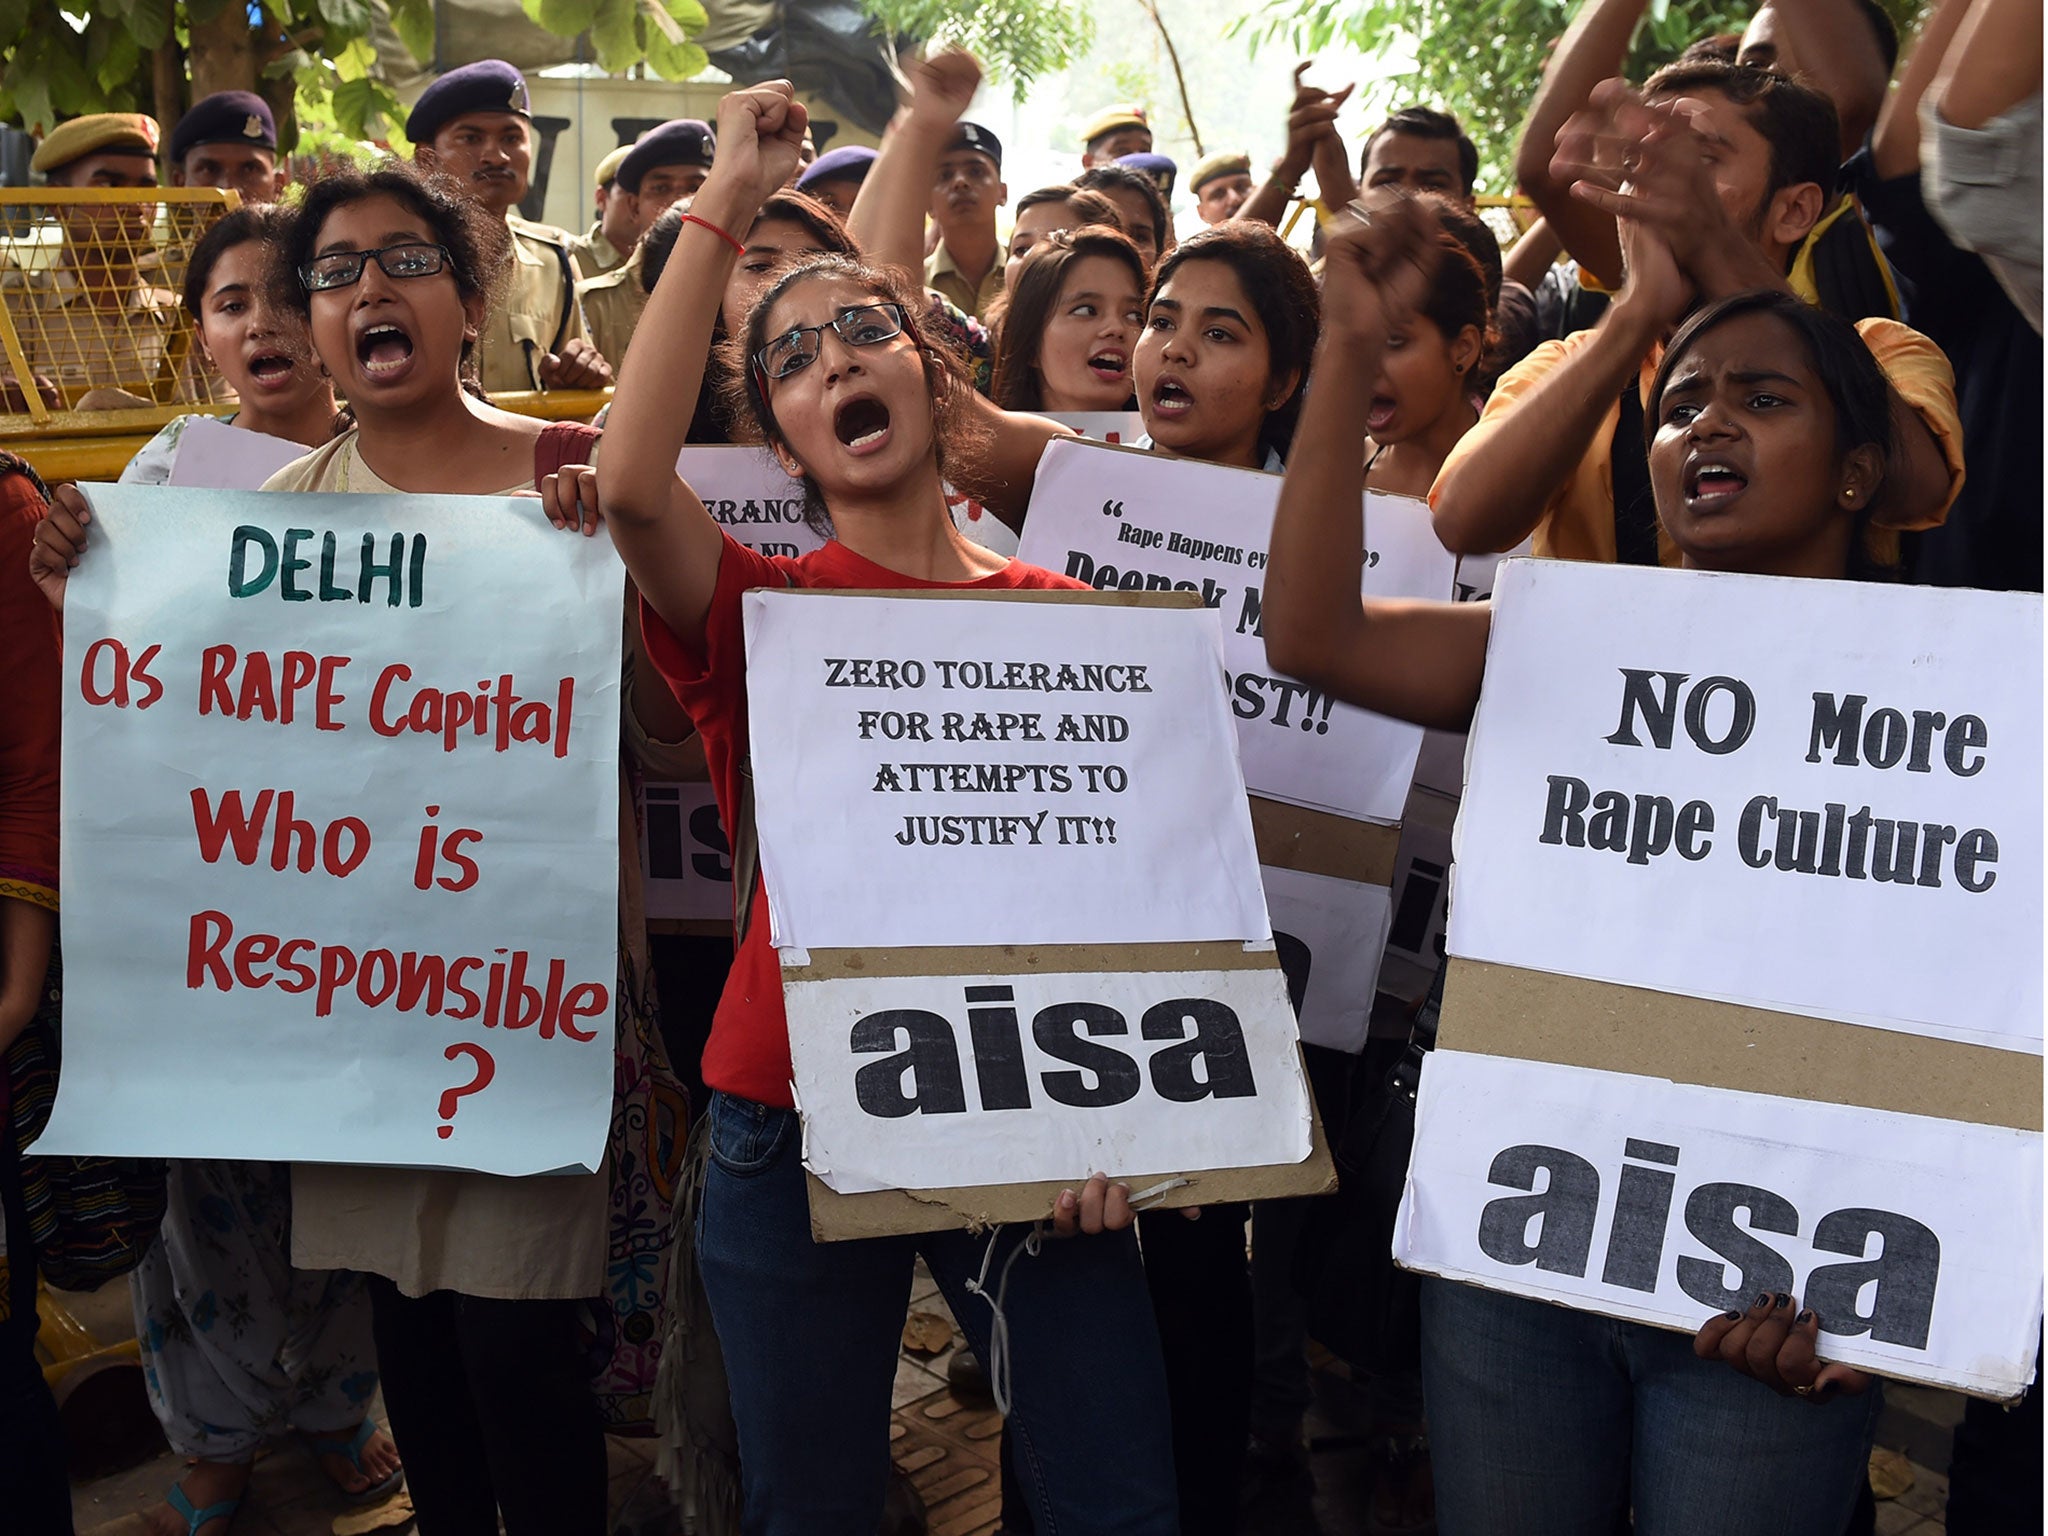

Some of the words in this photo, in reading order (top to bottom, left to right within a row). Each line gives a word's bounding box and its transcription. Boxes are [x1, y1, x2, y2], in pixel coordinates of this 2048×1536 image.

[228, 525, 427, 609] DELHI
[1117, 522, 1164, 549] Rape
[1167, 531, 1244, 565] Happens
[1247, 550, 1270, 570] ev
[200, 644, 350, 731] RAPE
[369, 664, 574, 758] Capital
[824, 658, 925, 691] ZERO
[933, 660, 1153, 693] TOLERANCE
[1602, 668, 1756, 755] NO
[1805, 692, 1988, 777] More
[857, 711, 934, 743] FOR
[941, 712, 1046, 743] RAPE
[1054, 714, 1129, 743] AND
[872, 763, 1073, 793] ATTEMPTS
[1077, 765, 1128, 793] TO
[894, 810, 1049, 846] JUSTIFY
[1055, 816, 1117, 845] IT!!
[191, 788, 371, 878] Who
[415, 805, 483, 892] is
[1539, 775, 1715, 866] Rape
[1737, 795, 1999, 893] Culture
[187, 910, 609, 1042] Responsible
[438, 1043, 495, 1139] ?
[850, 984, 1258, 1119] aisa
[1478, 1137, 1940, 1350] aisa
